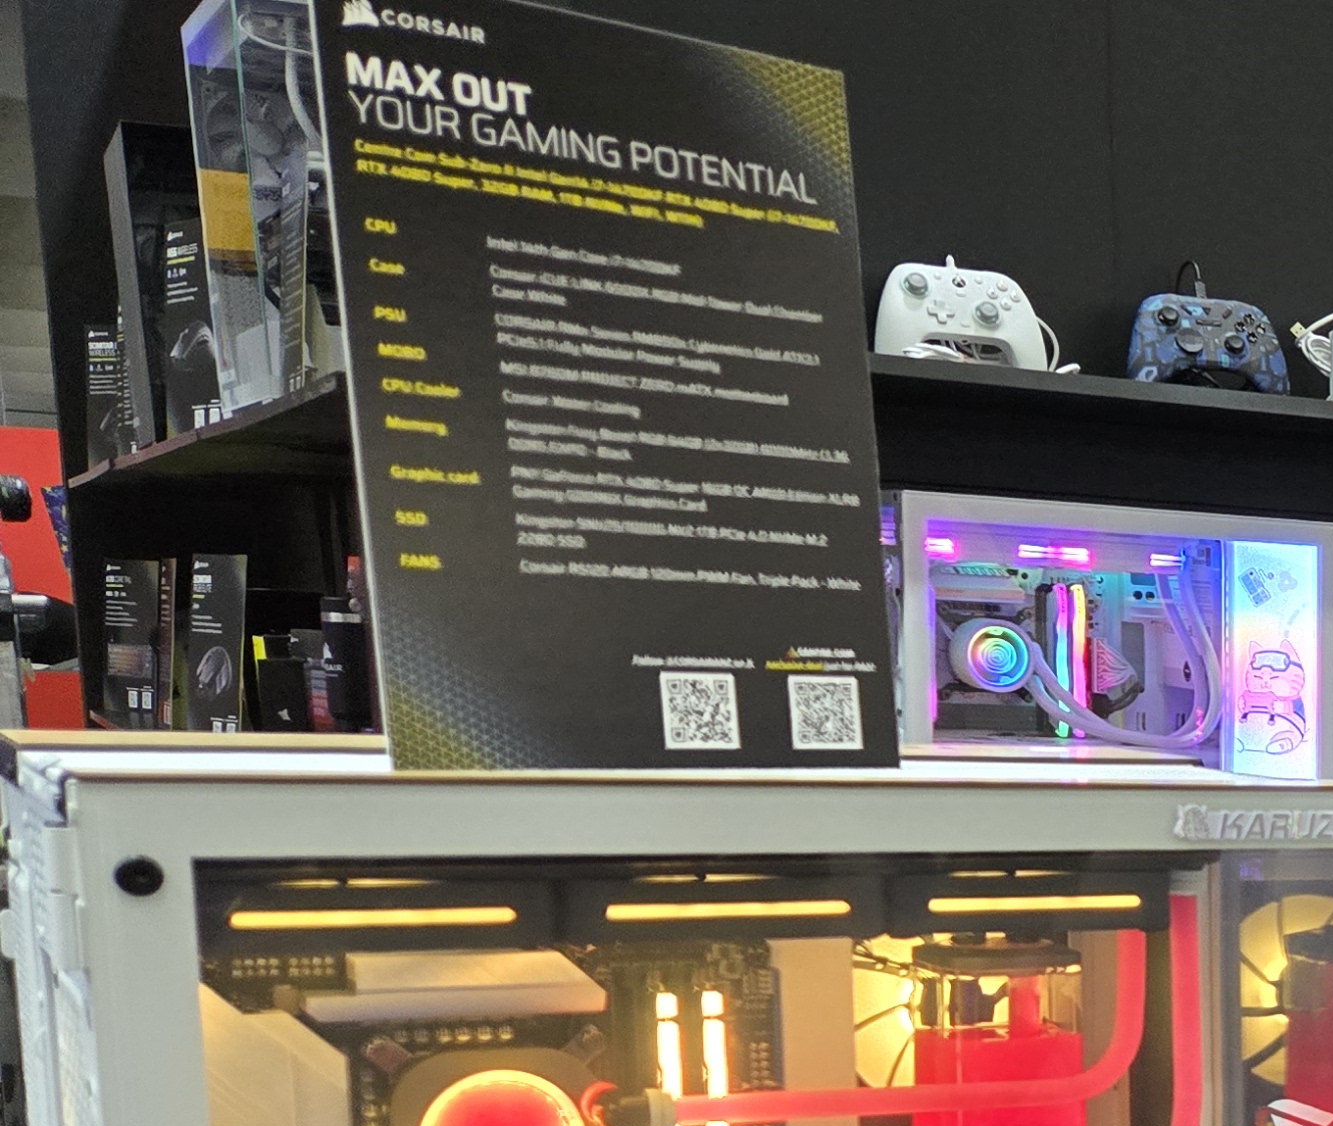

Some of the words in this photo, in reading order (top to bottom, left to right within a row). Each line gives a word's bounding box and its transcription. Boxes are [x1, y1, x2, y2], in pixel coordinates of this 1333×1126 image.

[381, 9, 486, 45] CORSAIR
[346, 51, 444, 102] MAX
[454, 73, 533, 118] OUT
[348, 90, 461, 143] YOUR
[471, 112, 622, 171] GAMING
[631, 142, 818, 205] POTENTIAL
[364, 217, 398, 235] CPU
[373, 305, 408, 323] PSU
[395, 510, 430, 527] SSD
[400, 553, 442, 570] FANS
